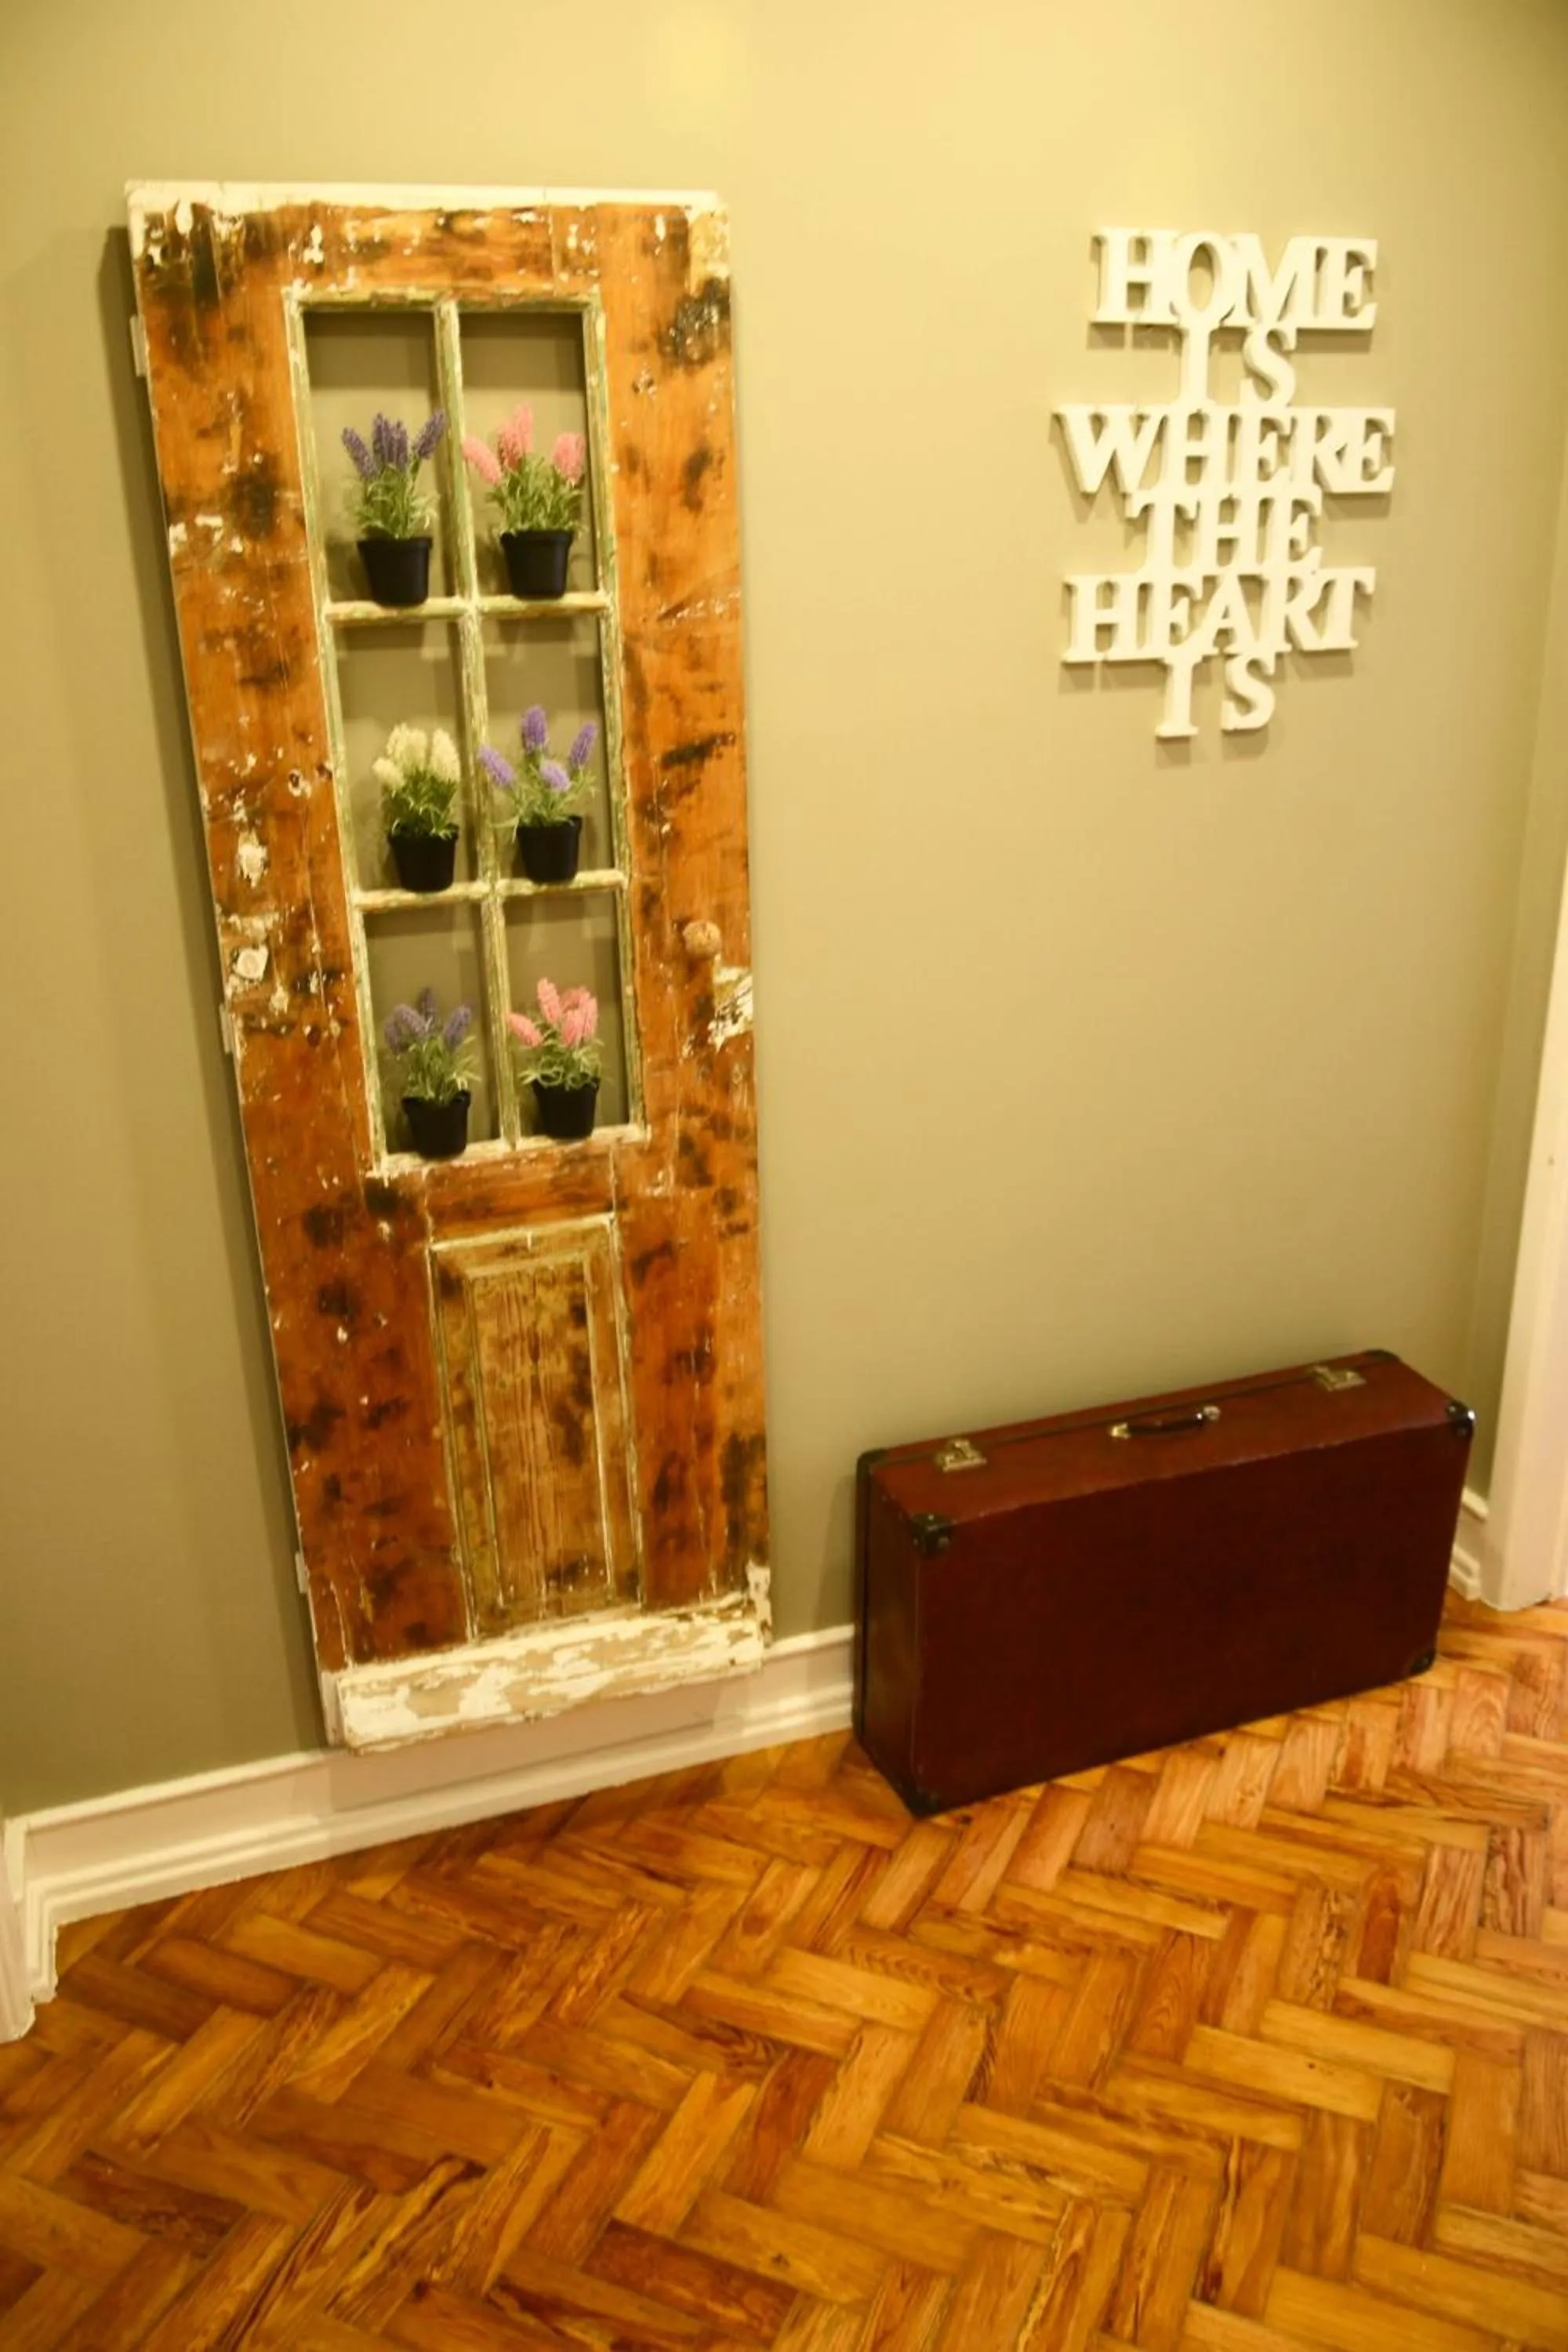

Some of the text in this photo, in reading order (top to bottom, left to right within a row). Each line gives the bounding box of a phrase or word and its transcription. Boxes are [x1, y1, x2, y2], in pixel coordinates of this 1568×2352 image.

[1091, 227, 1377, 330] HOME
[1172, 314, 1298, 411] IS
[1051, 402, 1396, 495] WHERE
[1126, 486, 1323, 574] THE
[1061, 568, 1376, 663] HEART
[1155, 652, 1276, 738] IS
